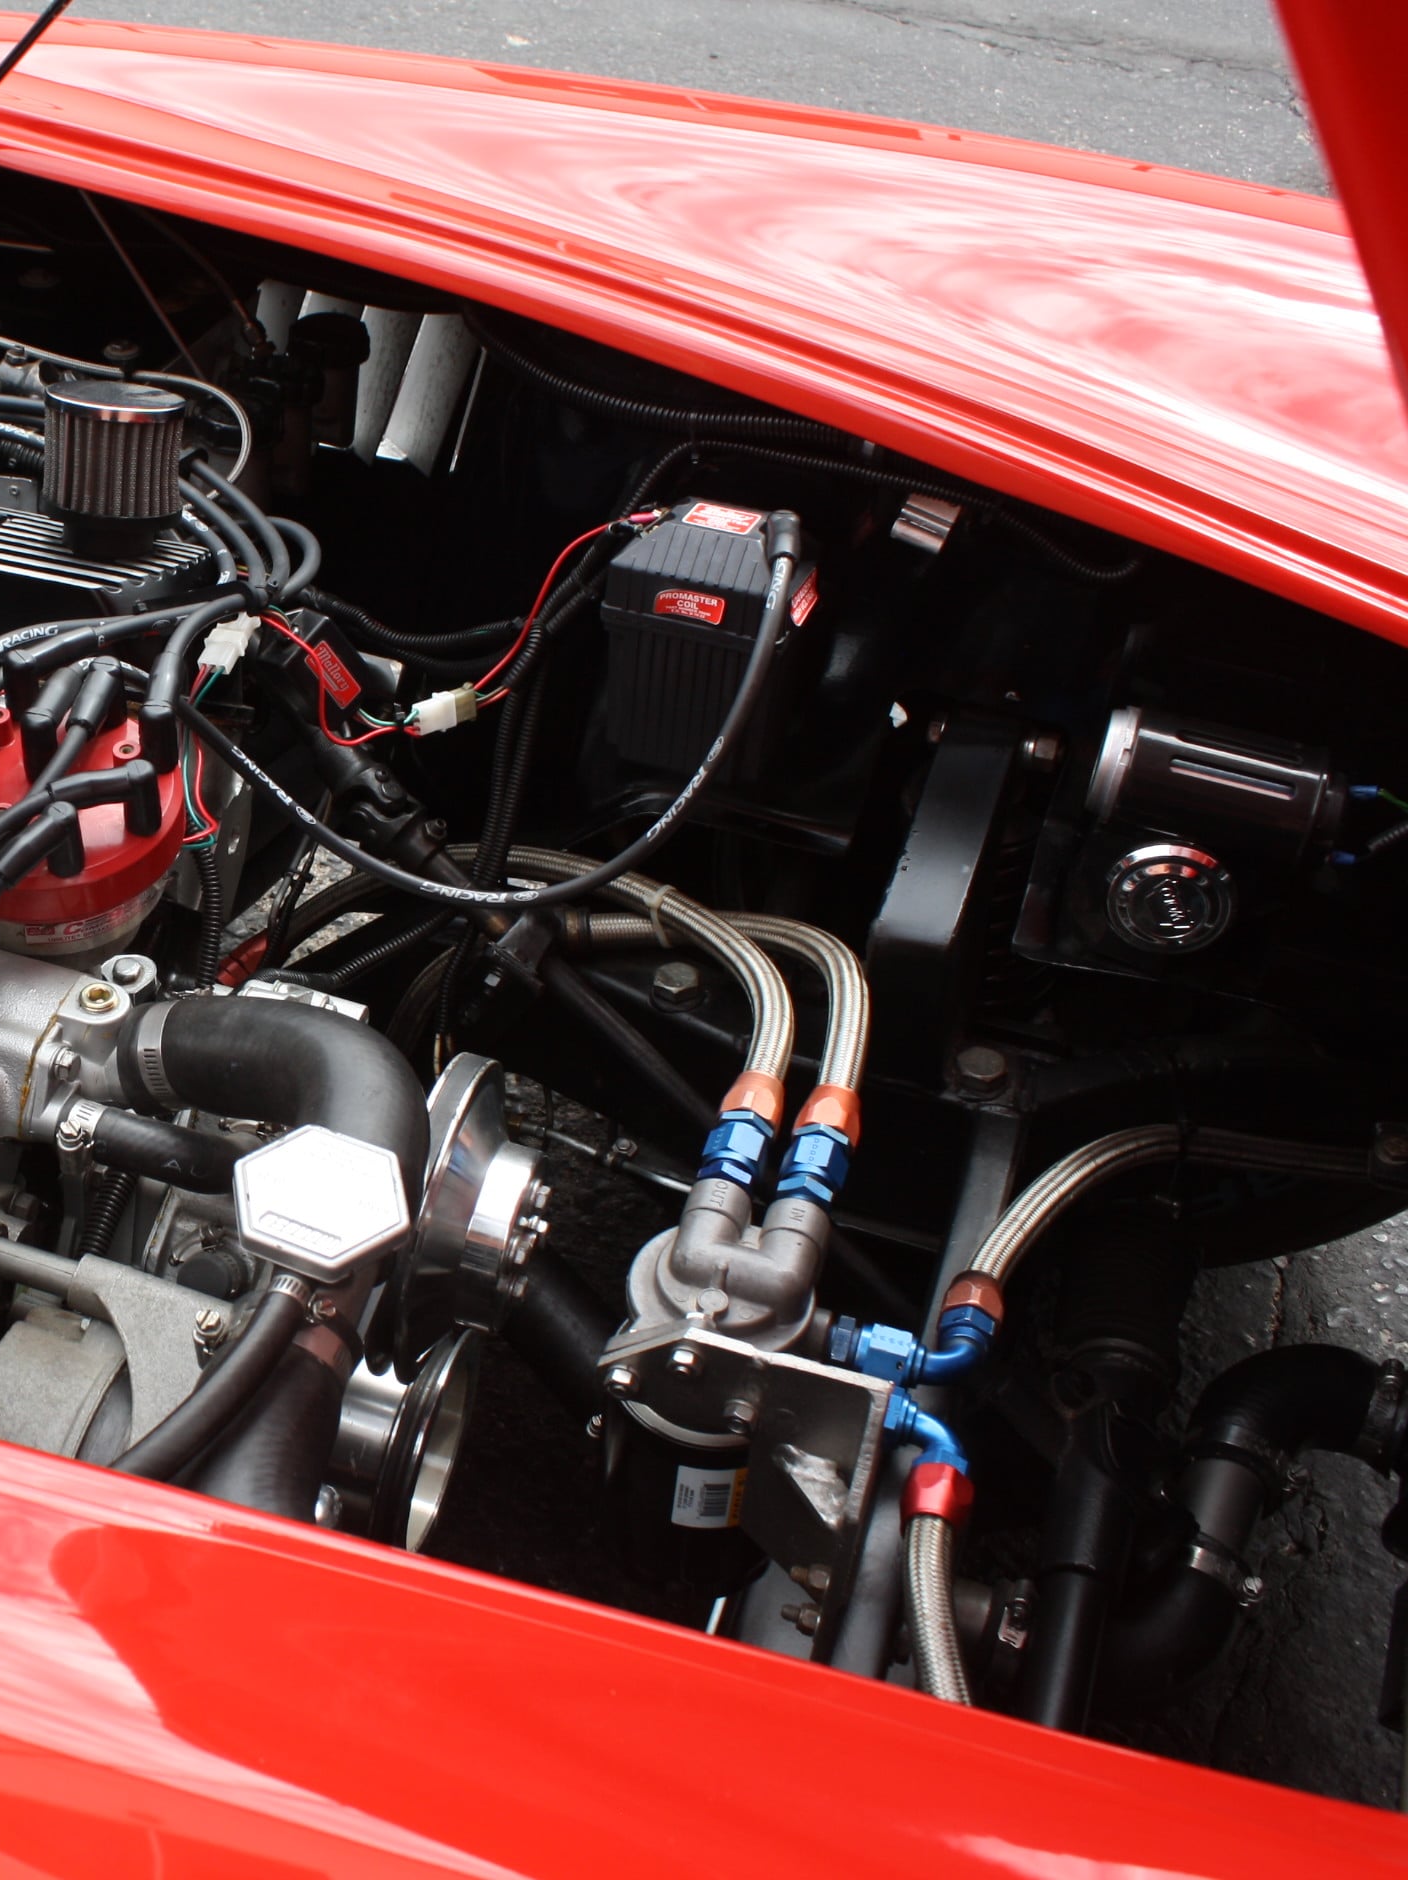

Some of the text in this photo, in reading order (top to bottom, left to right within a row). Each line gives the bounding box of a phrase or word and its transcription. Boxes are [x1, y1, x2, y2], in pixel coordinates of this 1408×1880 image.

[659, 591, 719, 608] PROMASTER
[676, 599, 699, 611] COIL
[316, 645, 350, 692] Mallory
[231, 745, 293, 807] RACING
[646, 765, 708, 843] RACING
[419, 881, 508, 904] RACING
[709, 1180, 729, 1208] OUT
[789, 1207, 806, 1223] IN
